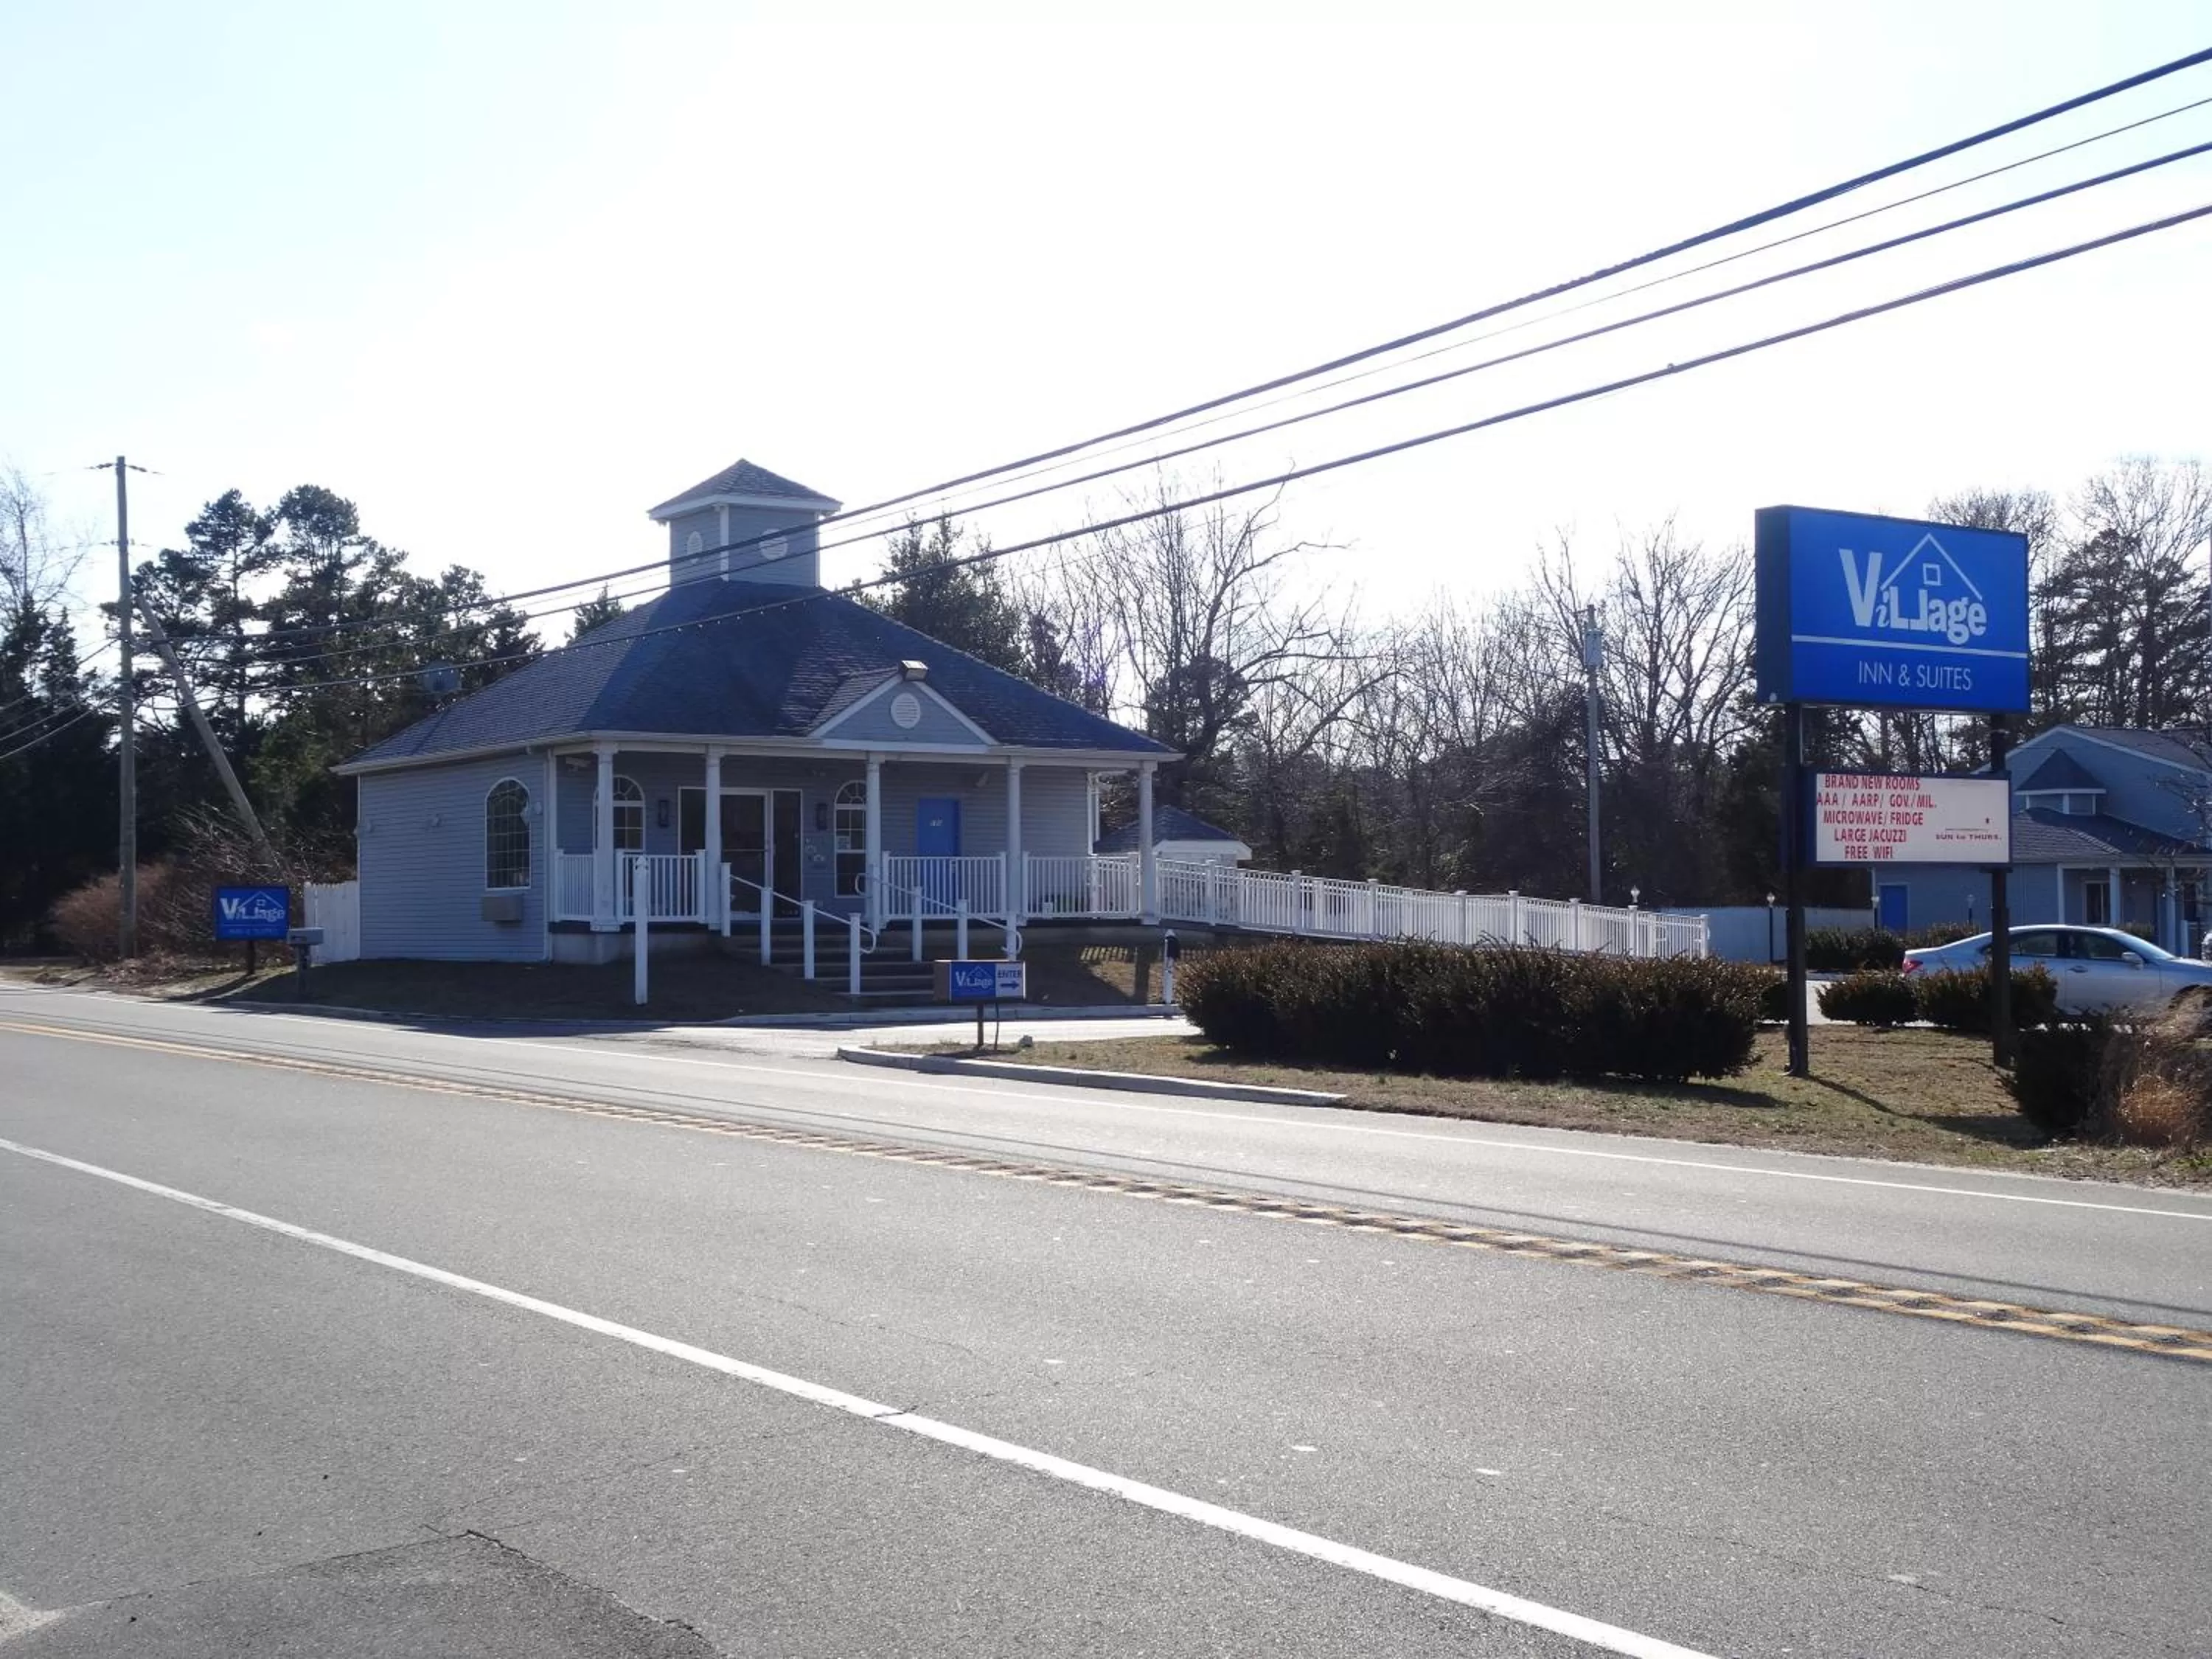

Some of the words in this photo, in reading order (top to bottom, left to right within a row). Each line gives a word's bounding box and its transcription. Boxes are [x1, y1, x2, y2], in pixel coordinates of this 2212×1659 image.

[1859, 661, 1893, 684] INN
[1899, 664, 1910, 686] &
[1917, 664, 1972, 691] SUITES
[1825, 775, 1858, 789] BRAND
[1862, 776, 1882, 790] NEW
[1886, 776, 1920, 791] ROOMS
[1817, 792, 1838, 806] AAA
[1891, 812, 1923, 825] FRIDGE
[1834, 828, 1866, 841] LARGE
[1868, 829, 1907, 842] JACUZZI
[1845, 846, 1868, 859] FREE
[1873, 846, 1893, 859] WIFI
[998, 970, 1021, 978] ENTER
